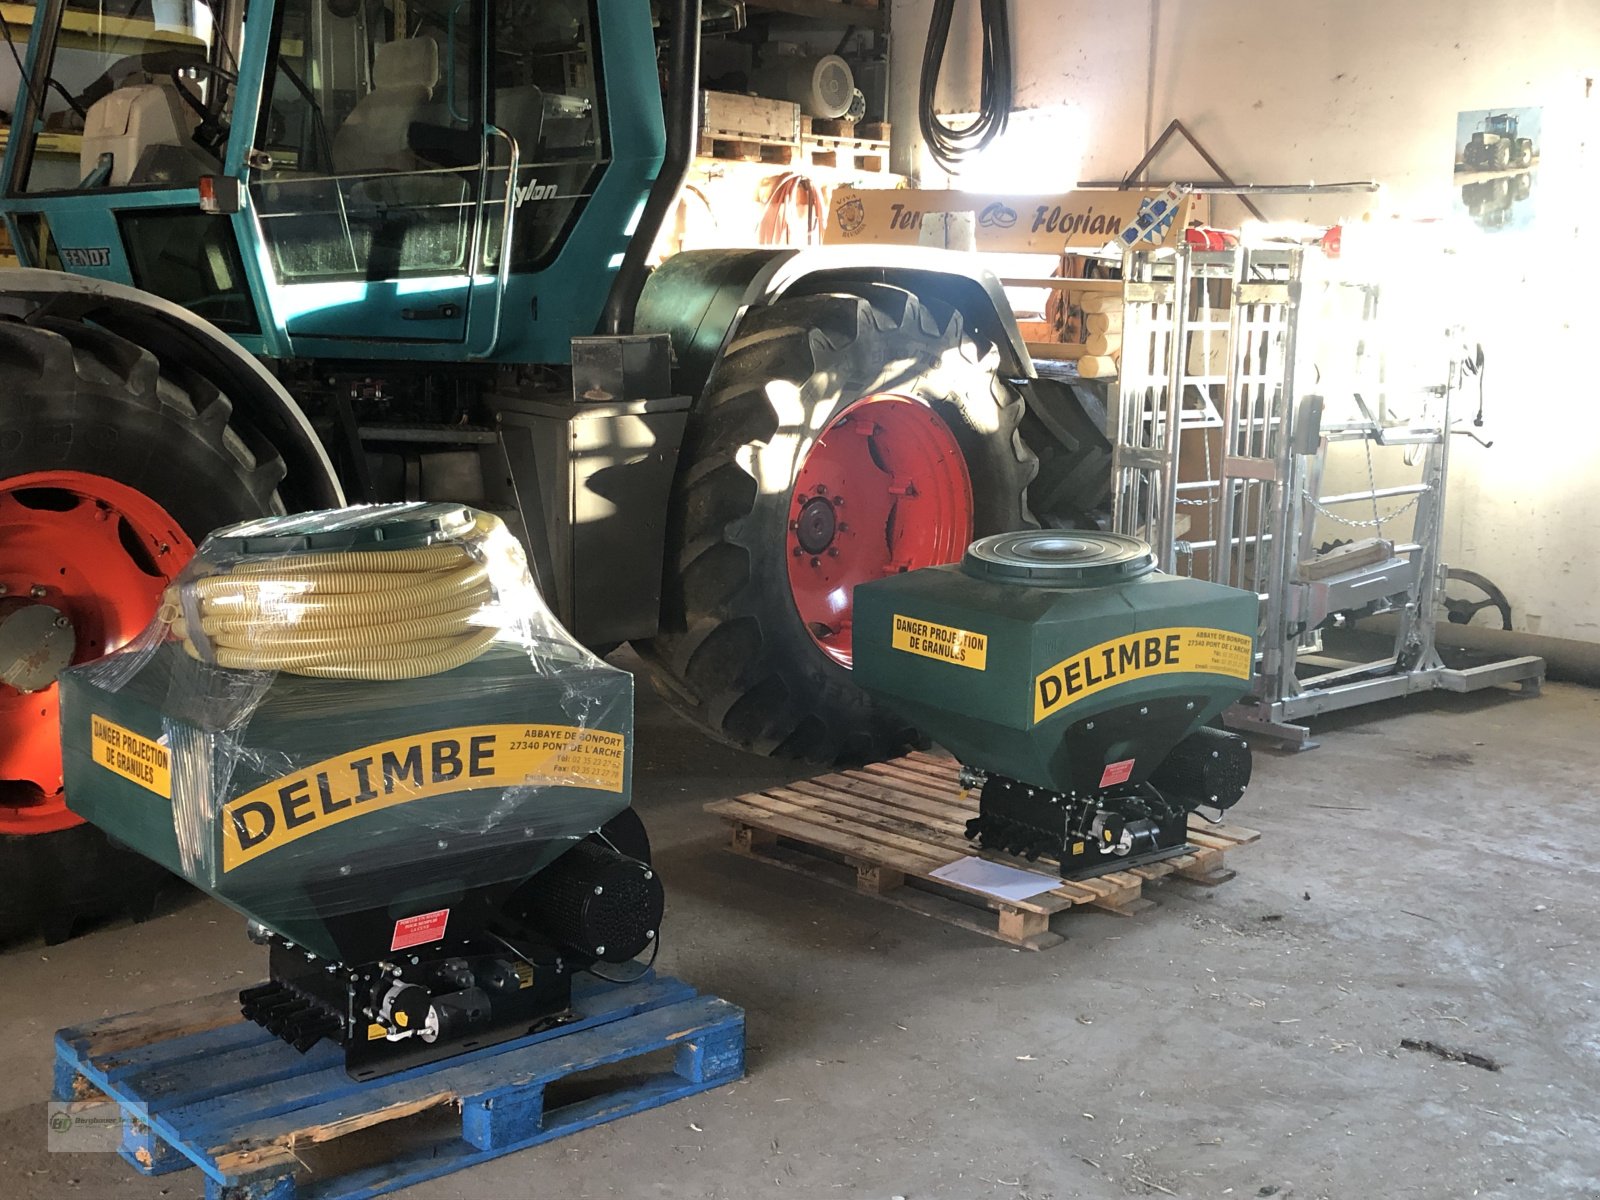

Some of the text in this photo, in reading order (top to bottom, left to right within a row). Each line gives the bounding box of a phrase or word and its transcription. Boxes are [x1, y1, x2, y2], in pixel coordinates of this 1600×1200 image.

[505, 178, 558, 208] ylon
[836, 193, 857, 206] VIVA
[889, 203, 1122, 235] Ter Florian
[62, 248, 109, 266] FENDT
[896, 618, 928, 638] DANGER
[909, 636, 920, 650] DE
[1039, 634, 1181, 710] DELIMBE
[94, 721, 168, 770] DANGER PROJECTION
[524, 729, 562, 739] ABBAYE
[564, 731, 577, 740] DE
[510, 741, 540, 750] 27340
[542, 742, 567, 751] PONT
[585, 745, 622, 758] L'ARCHE
[106, 746, 154, 785] DE GRANULES
[231, 734, 497, 851] DELIMBE
